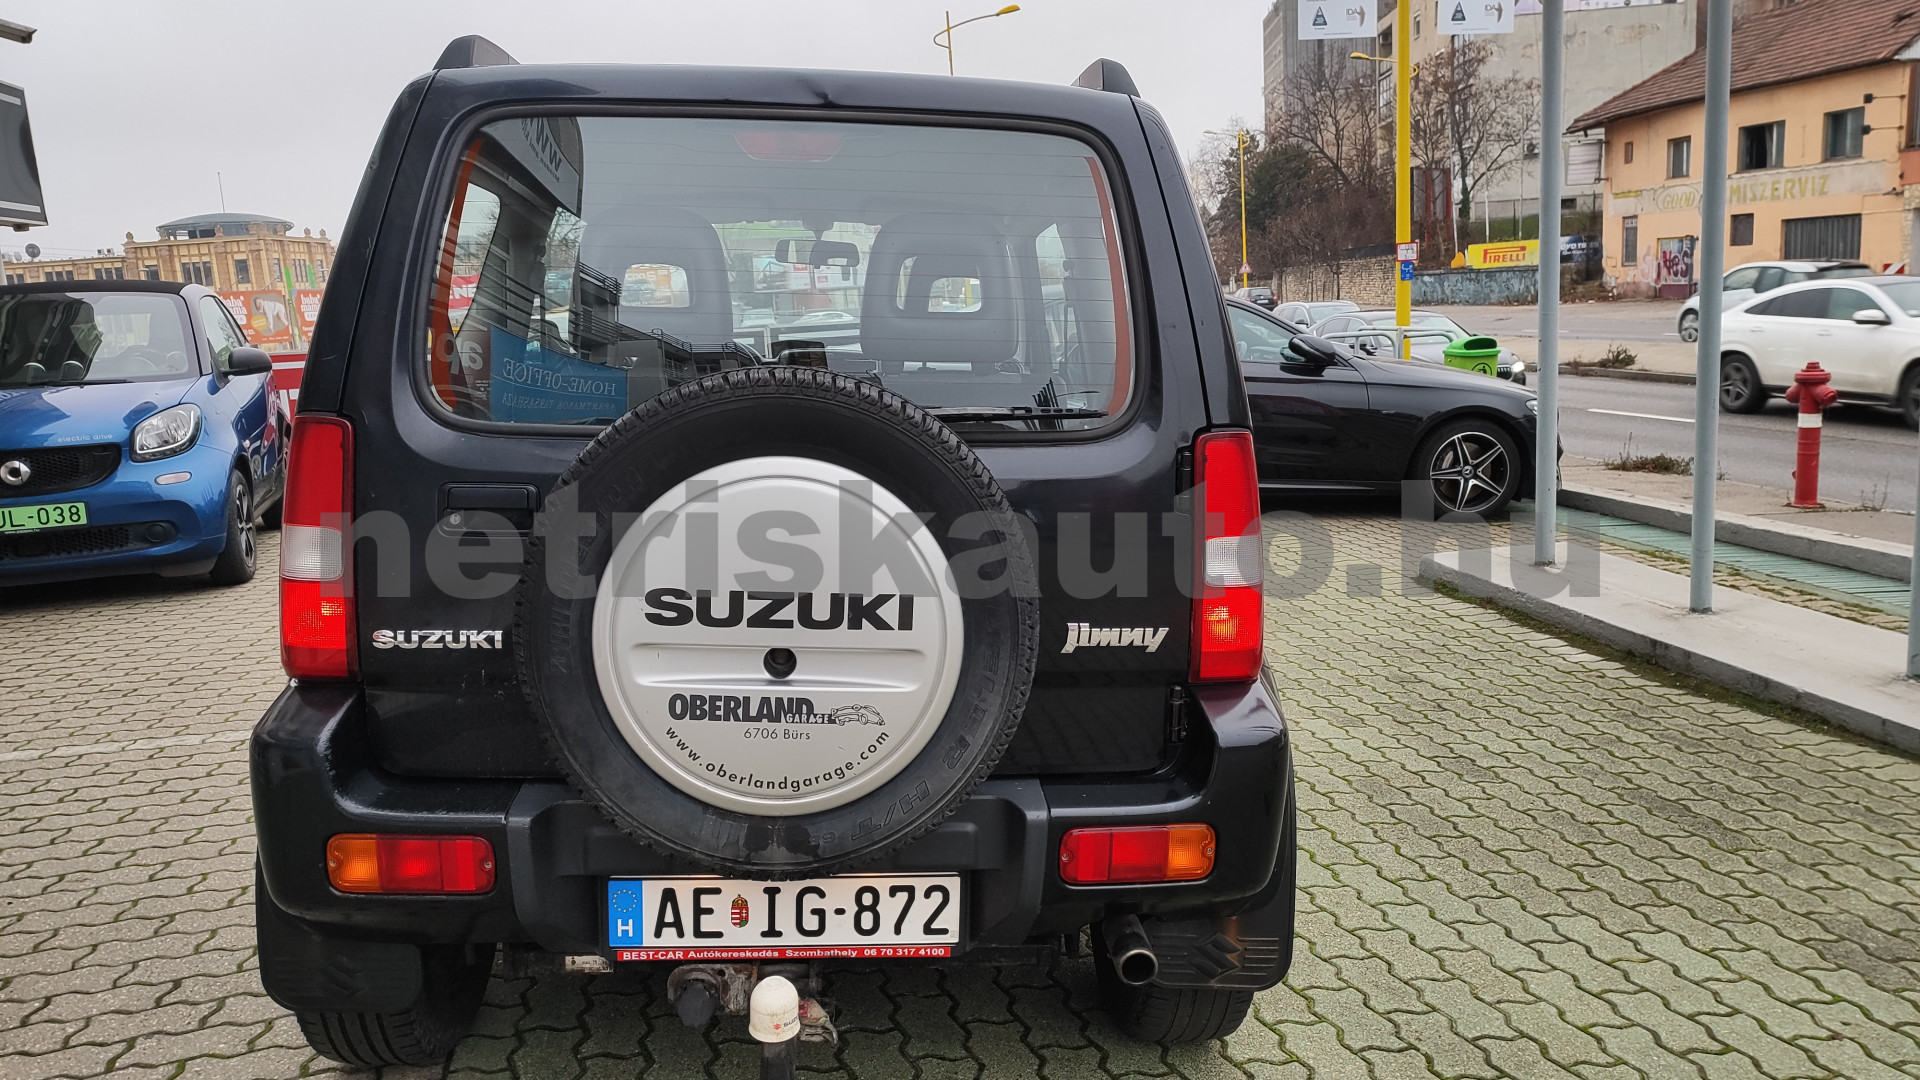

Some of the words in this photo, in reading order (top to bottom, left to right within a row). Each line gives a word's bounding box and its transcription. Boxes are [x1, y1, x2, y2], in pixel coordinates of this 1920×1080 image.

[1662, 191, 1696, 209] GOOD
[1728, 174, 1830, 205] MISZERVIZ
[1483, 245, 1527, 264] PIRELLI
[57, 434, 91, 443] electric
[93, 433, 113, 441] drive
[644, 587, 914, 631] SUZUKI
[372, 630, 503, 649] SUZUKI
[668, 693, 815, 723] OBERLAND
[785, 713, 830, 724] GARAGE
[743, 727, 778, 740] 6706
[782, 727, 811, 740] Bürs
[665, 727, 890, 793] www.oberlandgarage.com
[653, 887, 725, 939] AE
[760, 884, 950, 938] IG-872
[616, 918, 634, 938] H
[623, 951, 684, 960] BEST-CAR
[688, 950, 779, 958] Autókereskedés
[785, 949, 858, 958] Szombathely
[863, 948, 877, 956] 06
[880, 948, 893, 956] 70
[896, 948, 916, 956] 317
[918, 948, 945, 956] 4100
